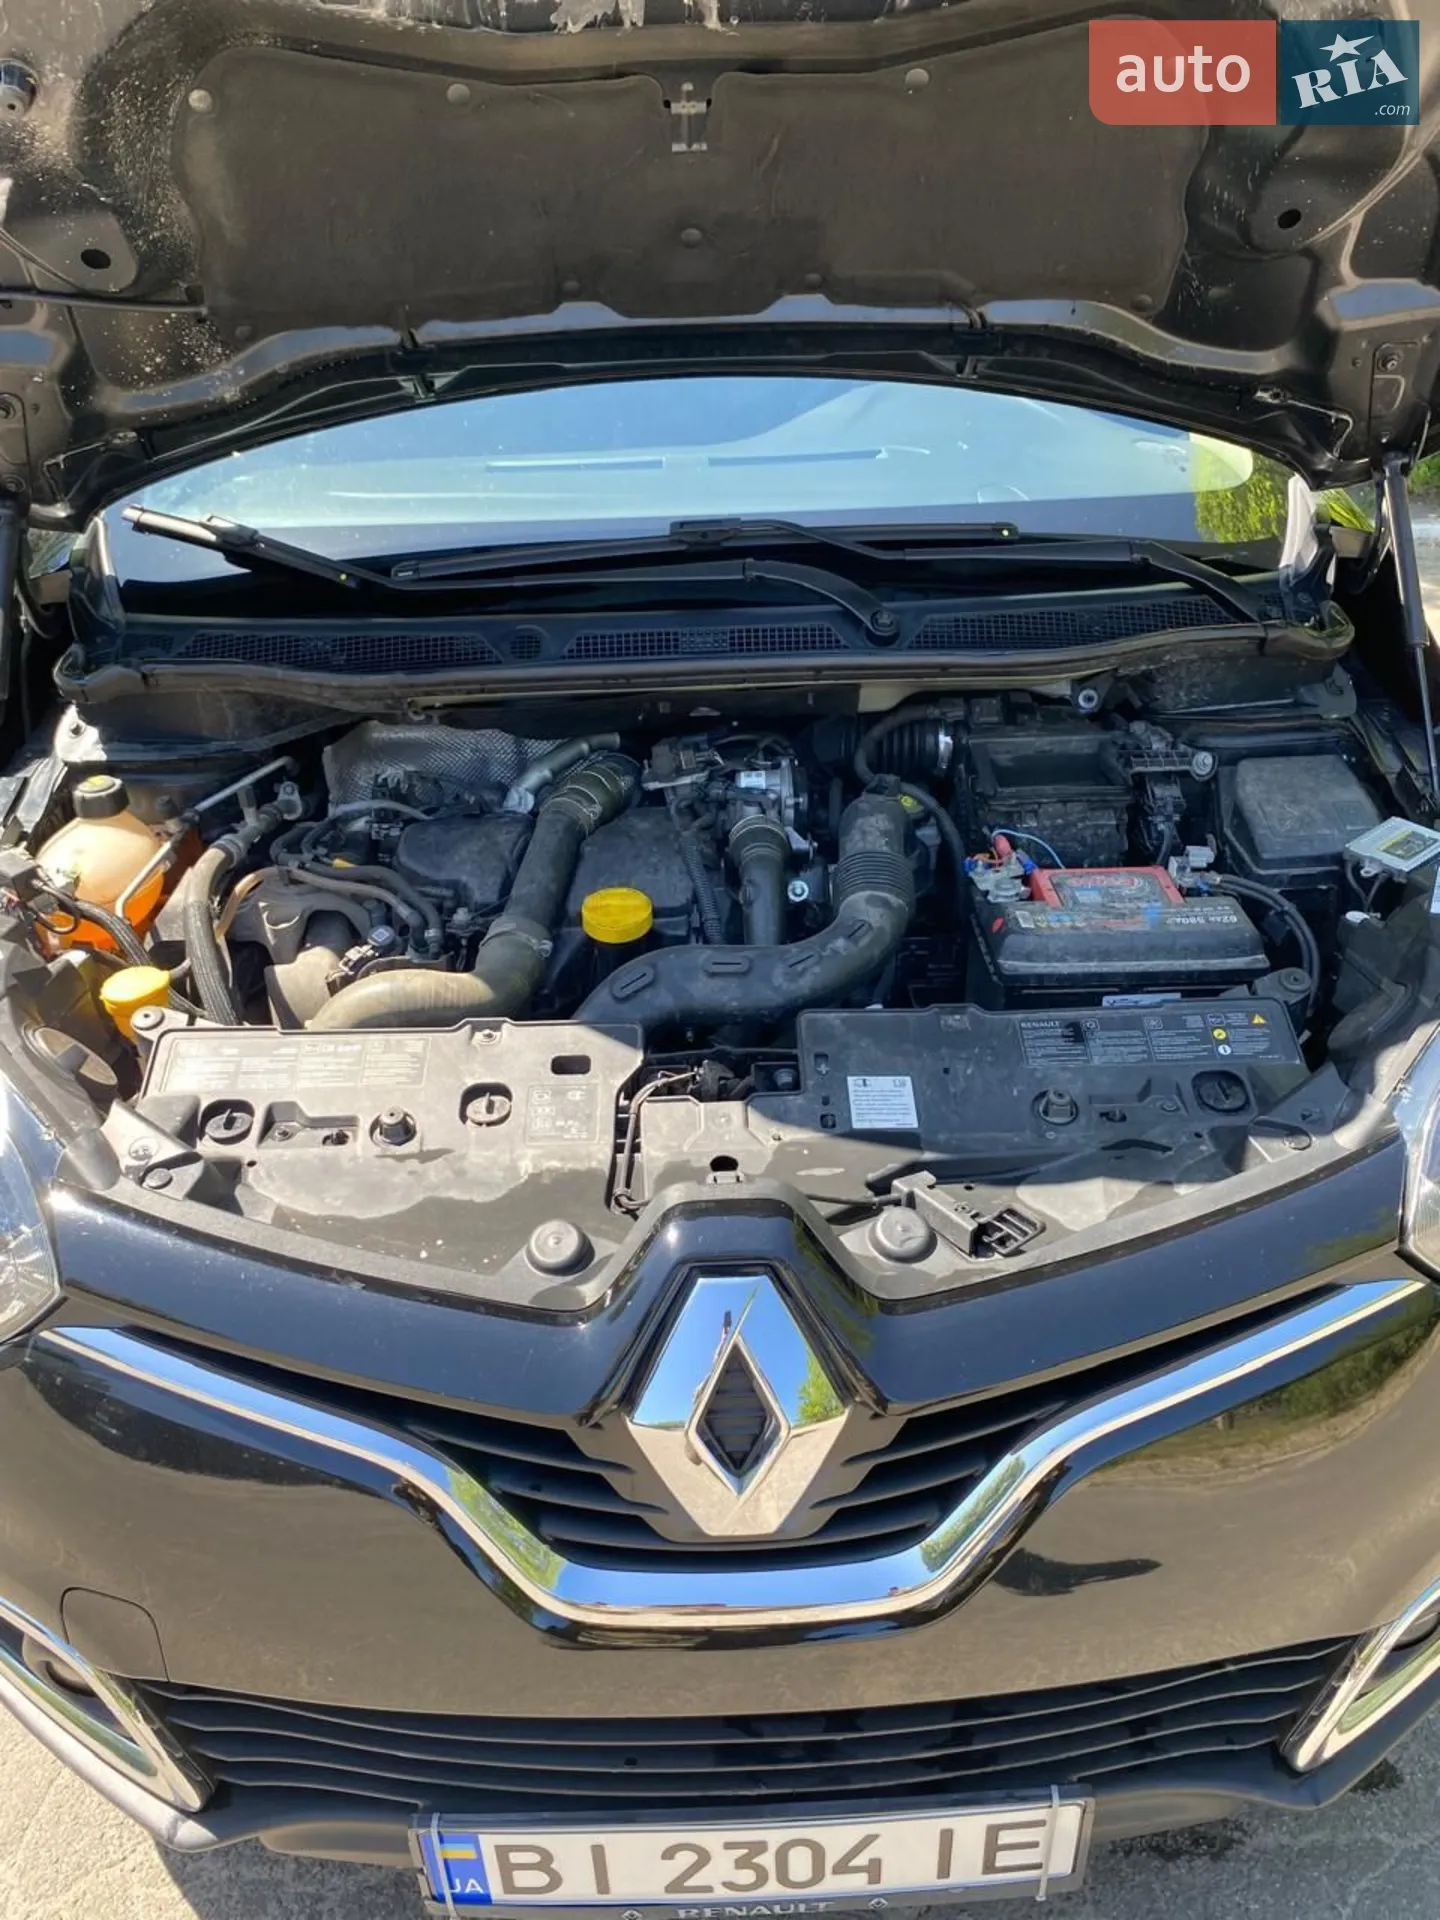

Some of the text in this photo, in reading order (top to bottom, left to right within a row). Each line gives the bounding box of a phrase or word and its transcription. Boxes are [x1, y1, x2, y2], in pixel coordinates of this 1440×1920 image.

[1020, 1020, 1060, 1029] RENAULT
[494, 1819, 1047, 1896] BI 2304 IE
[676, 1901, 836, 1919] RENAULT
